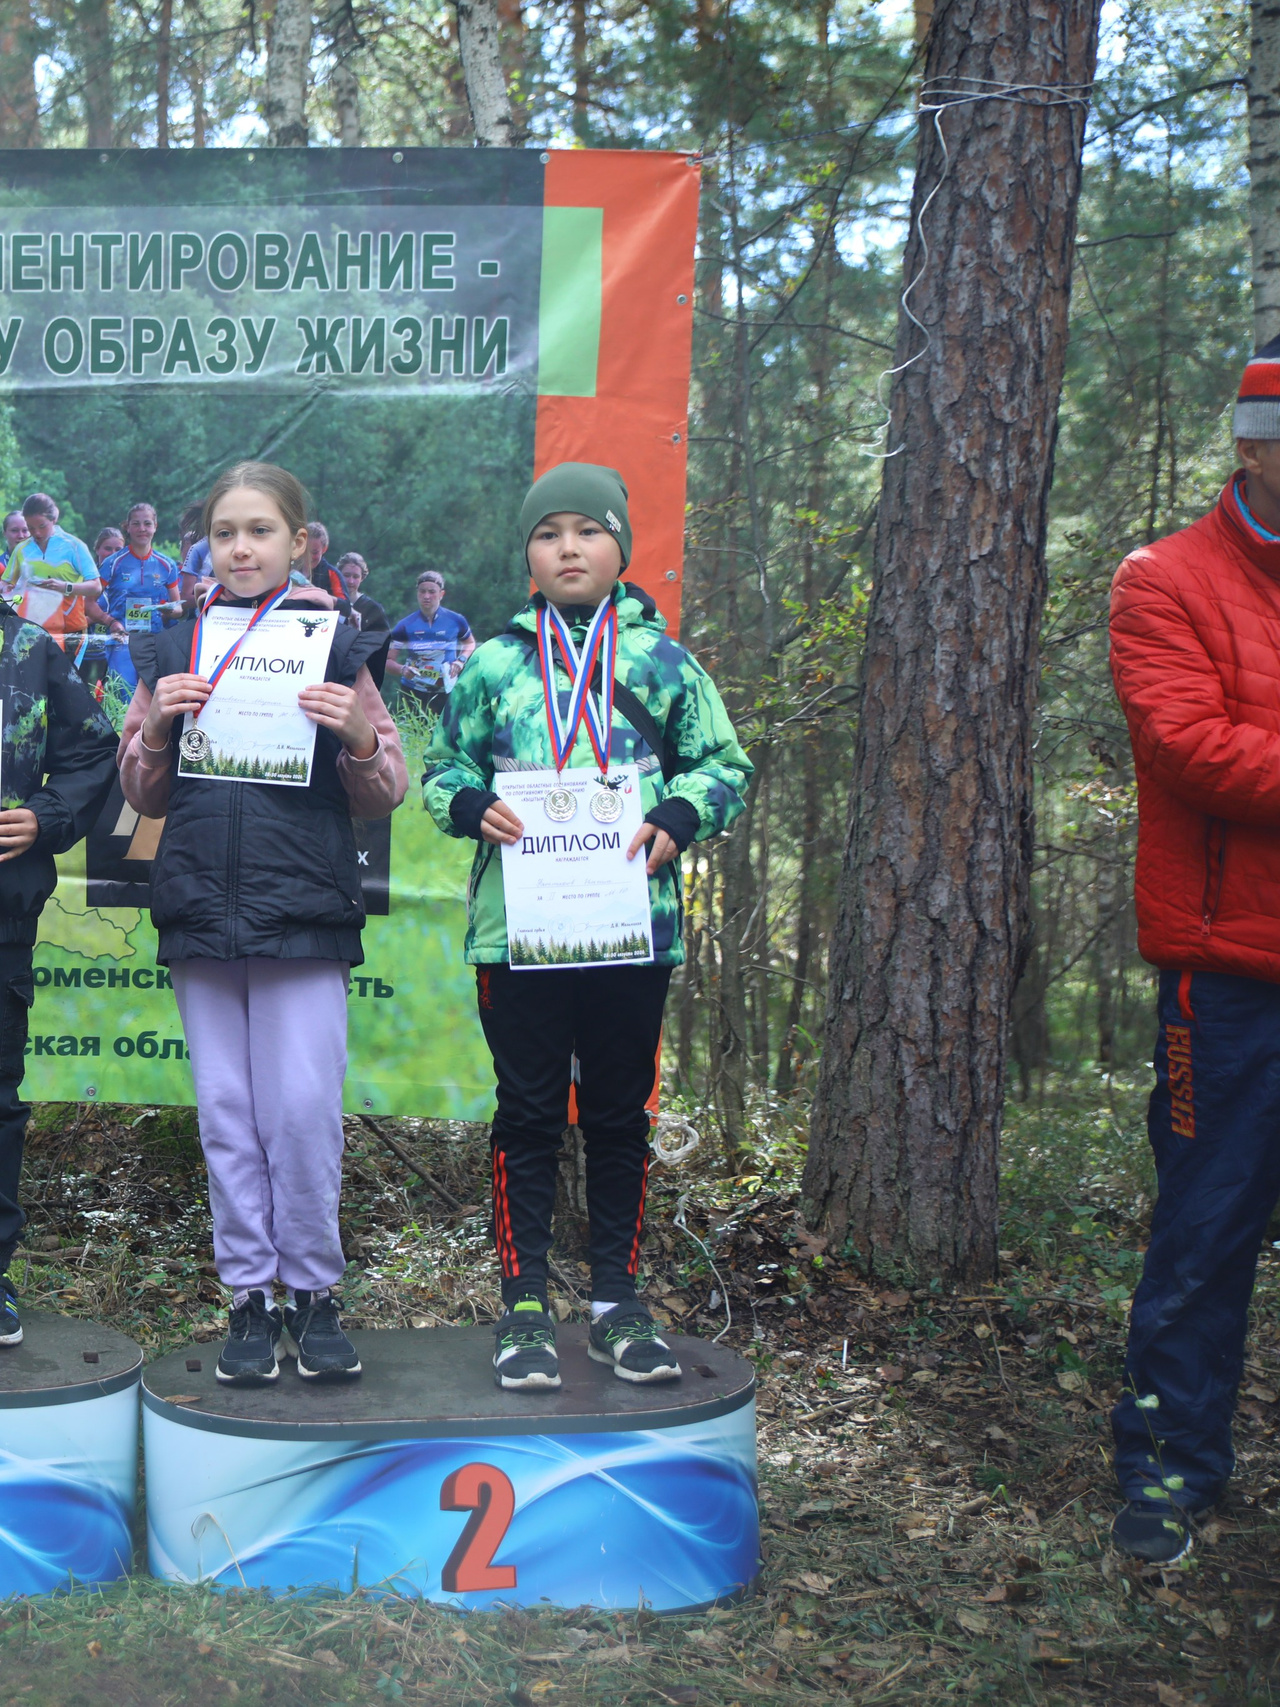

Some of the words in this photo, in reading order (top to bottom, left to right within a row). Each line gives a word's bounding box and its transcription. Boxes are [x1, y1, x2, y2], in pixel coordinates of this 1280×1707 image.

[43, 316, 276, 375] ОБРАЗУ
[296, 316, 508, 375] ЖИЗНИ
[521, 832, 620, 855] ДИПЛОМ
[1165, 1024, 1196, 1139] RUSSIA
[440, 1461, 517, 1593] 2
